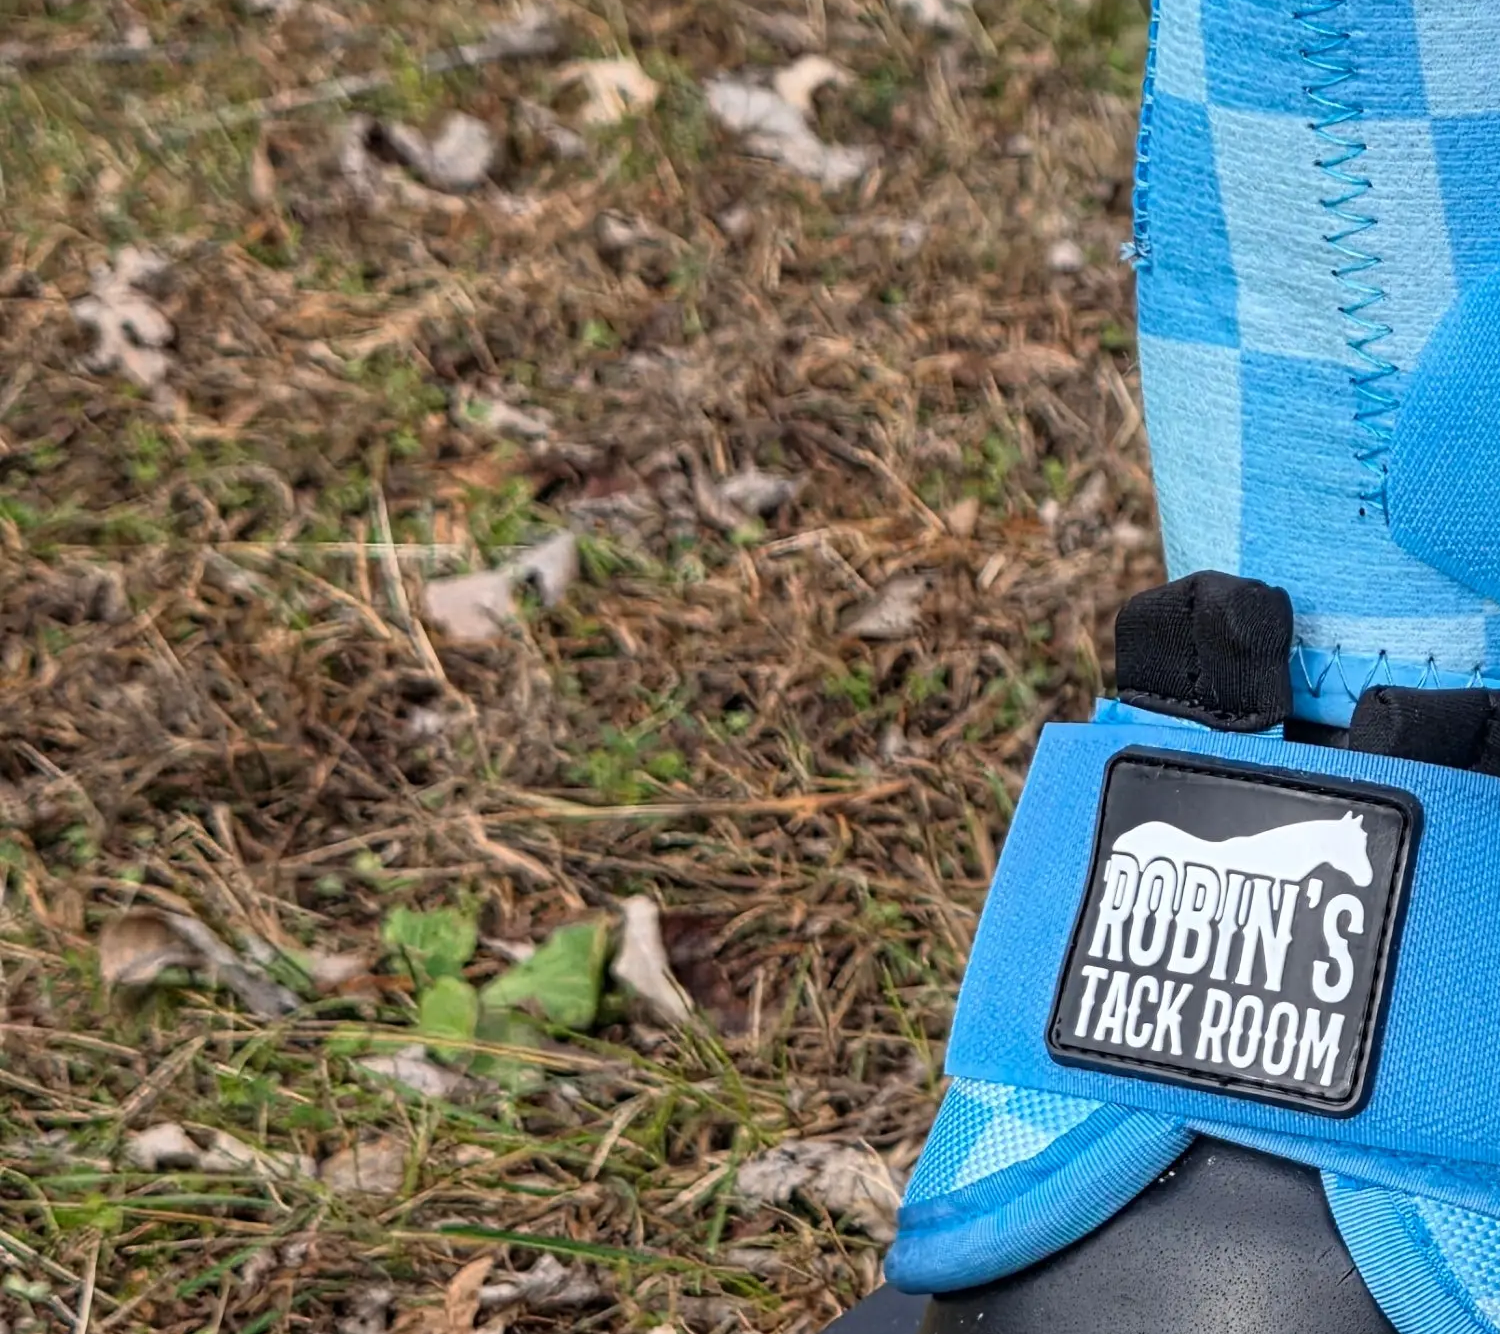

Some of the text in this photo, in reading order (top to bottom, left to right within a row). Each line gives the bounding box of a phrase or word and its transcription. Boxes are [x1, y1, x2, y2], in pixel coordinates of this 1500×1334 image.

[1088, 853, 1365, 1003] ROBIN'S
[1074, 965, 1345, 1086] TACK ROOM
